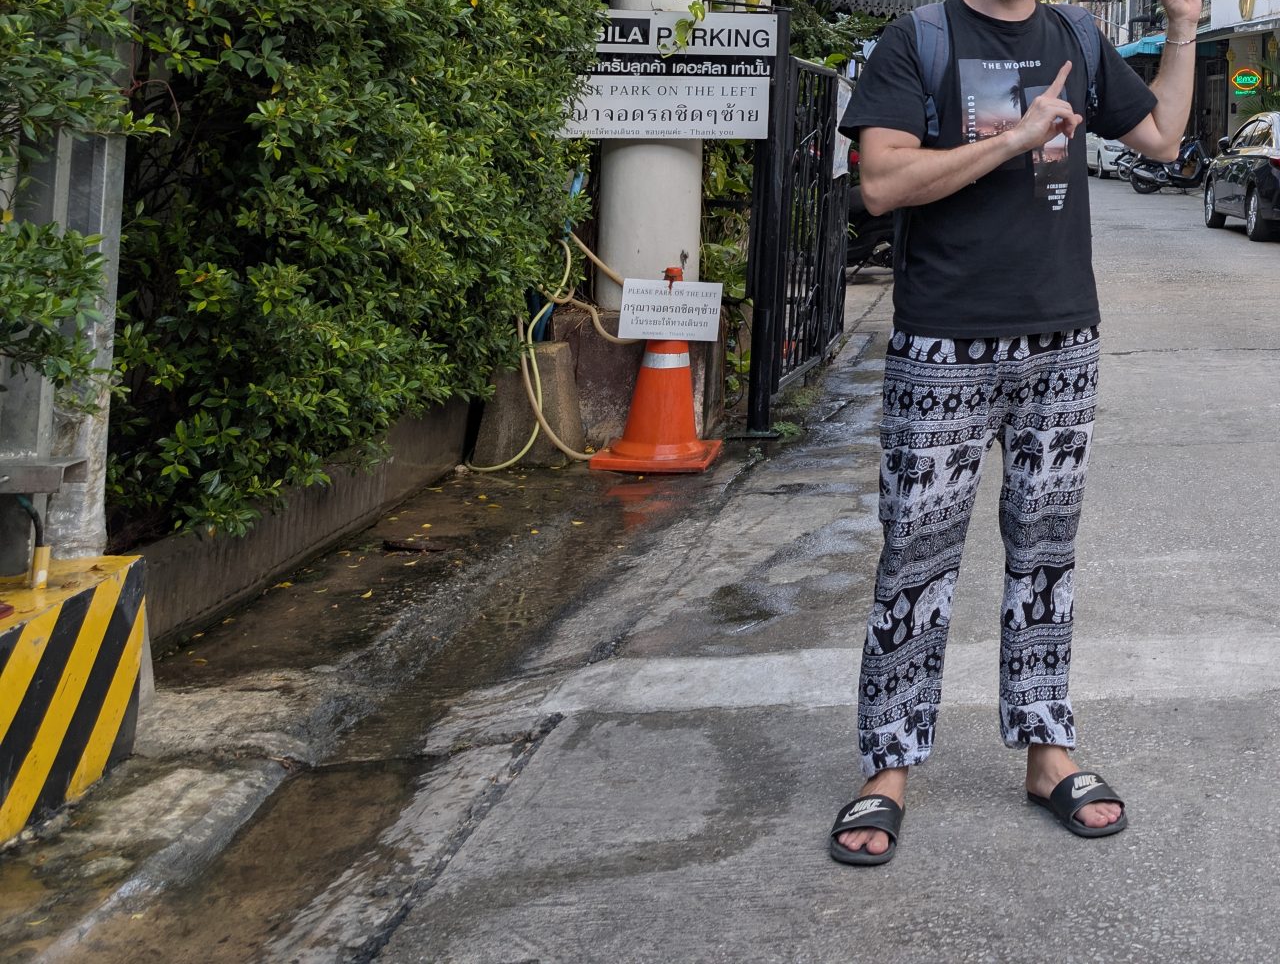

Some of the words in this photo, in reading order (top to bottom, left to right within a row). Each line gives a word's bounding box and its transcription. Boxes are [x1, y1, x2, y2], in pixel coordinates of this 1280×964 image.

[656, 26, 770, 49] PRKING
[731, 58, 771, 76] เท่านั้น
[982, 61, 1002, 71] THE
[610, 84, 651, 97] PARK
[657, 85, 679, 97] ON
[685, 85, 715, 97] THE
[720, 86, 758, 97] LEFT
[967, 95, 977, 144] COUNTLES
[690, 128, 717, 136] Thank
[1073, 774, 1098, 789] NIKE
[849, 798, 883, 814] NIKE
